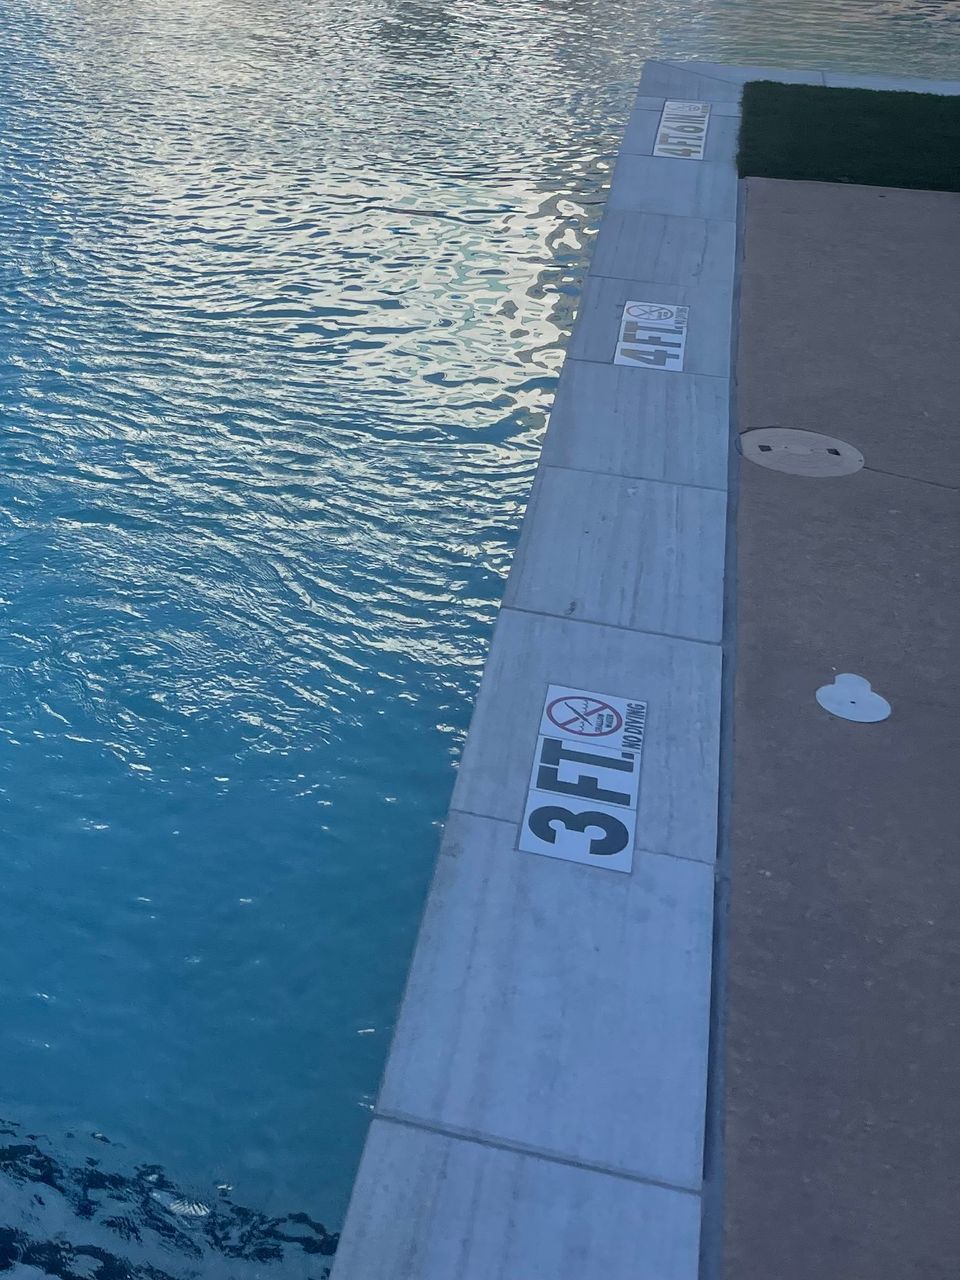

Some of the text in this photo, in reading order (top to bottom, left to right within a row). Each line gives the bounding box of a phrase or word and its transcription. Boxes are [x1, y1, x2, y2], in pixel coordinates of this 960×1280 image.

[662, 125, 705, 134] 6
[657, 148, 701, 157] 4
[620, 348, 680, 366] 4
[621, 702, 646, 750] NO DIVING
[528, 737, 635, 856] 3 FT.
